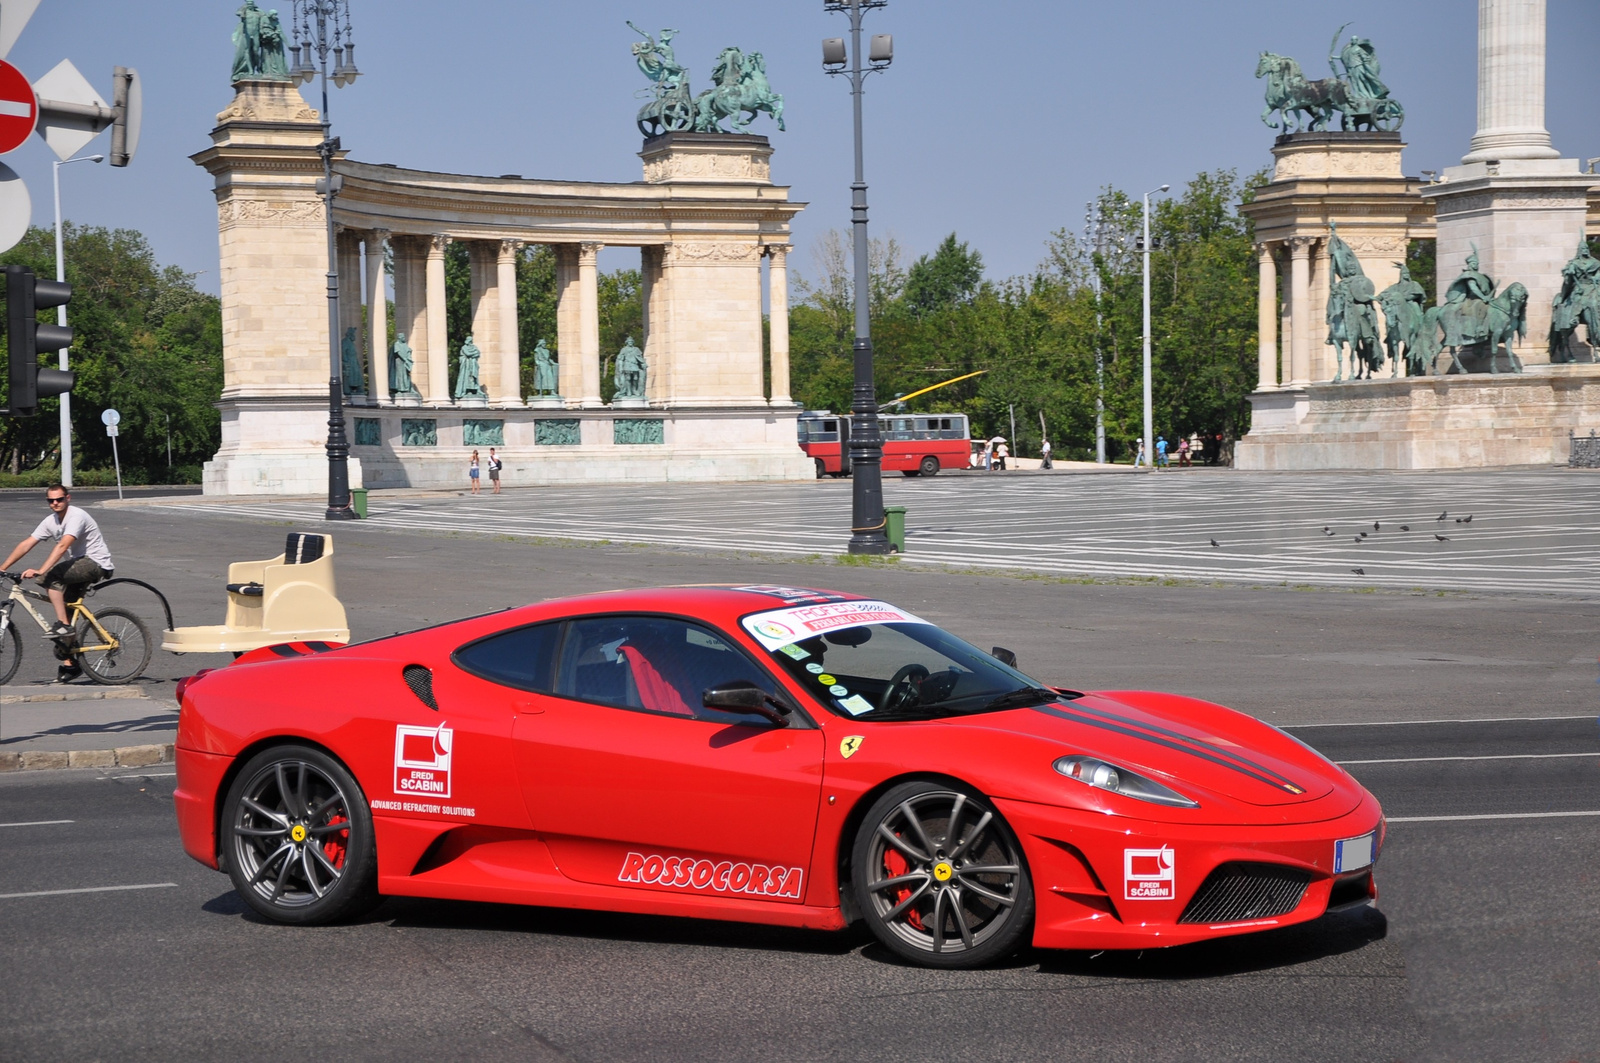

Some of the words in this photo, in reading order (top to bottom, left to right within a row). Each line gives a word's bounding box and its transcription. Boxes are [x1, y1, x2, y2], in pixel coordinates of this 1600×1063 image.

[788, 603, 857, 620] TROFEO
[809, 615, 851, 630] FERRARI
[411, 771, 434, 780] EREDI
[400, 778, 444, 792] SCABINI
[370, 800, 402, 811] ADVANCED
[402, 802, 441, 814] REFRACTORY
[442, 805, 475, 817] SOLUTIONS
[618, 852, 803, 898] ROSSOCORSA
[1131, 888, 1169, 896] SCABINI
